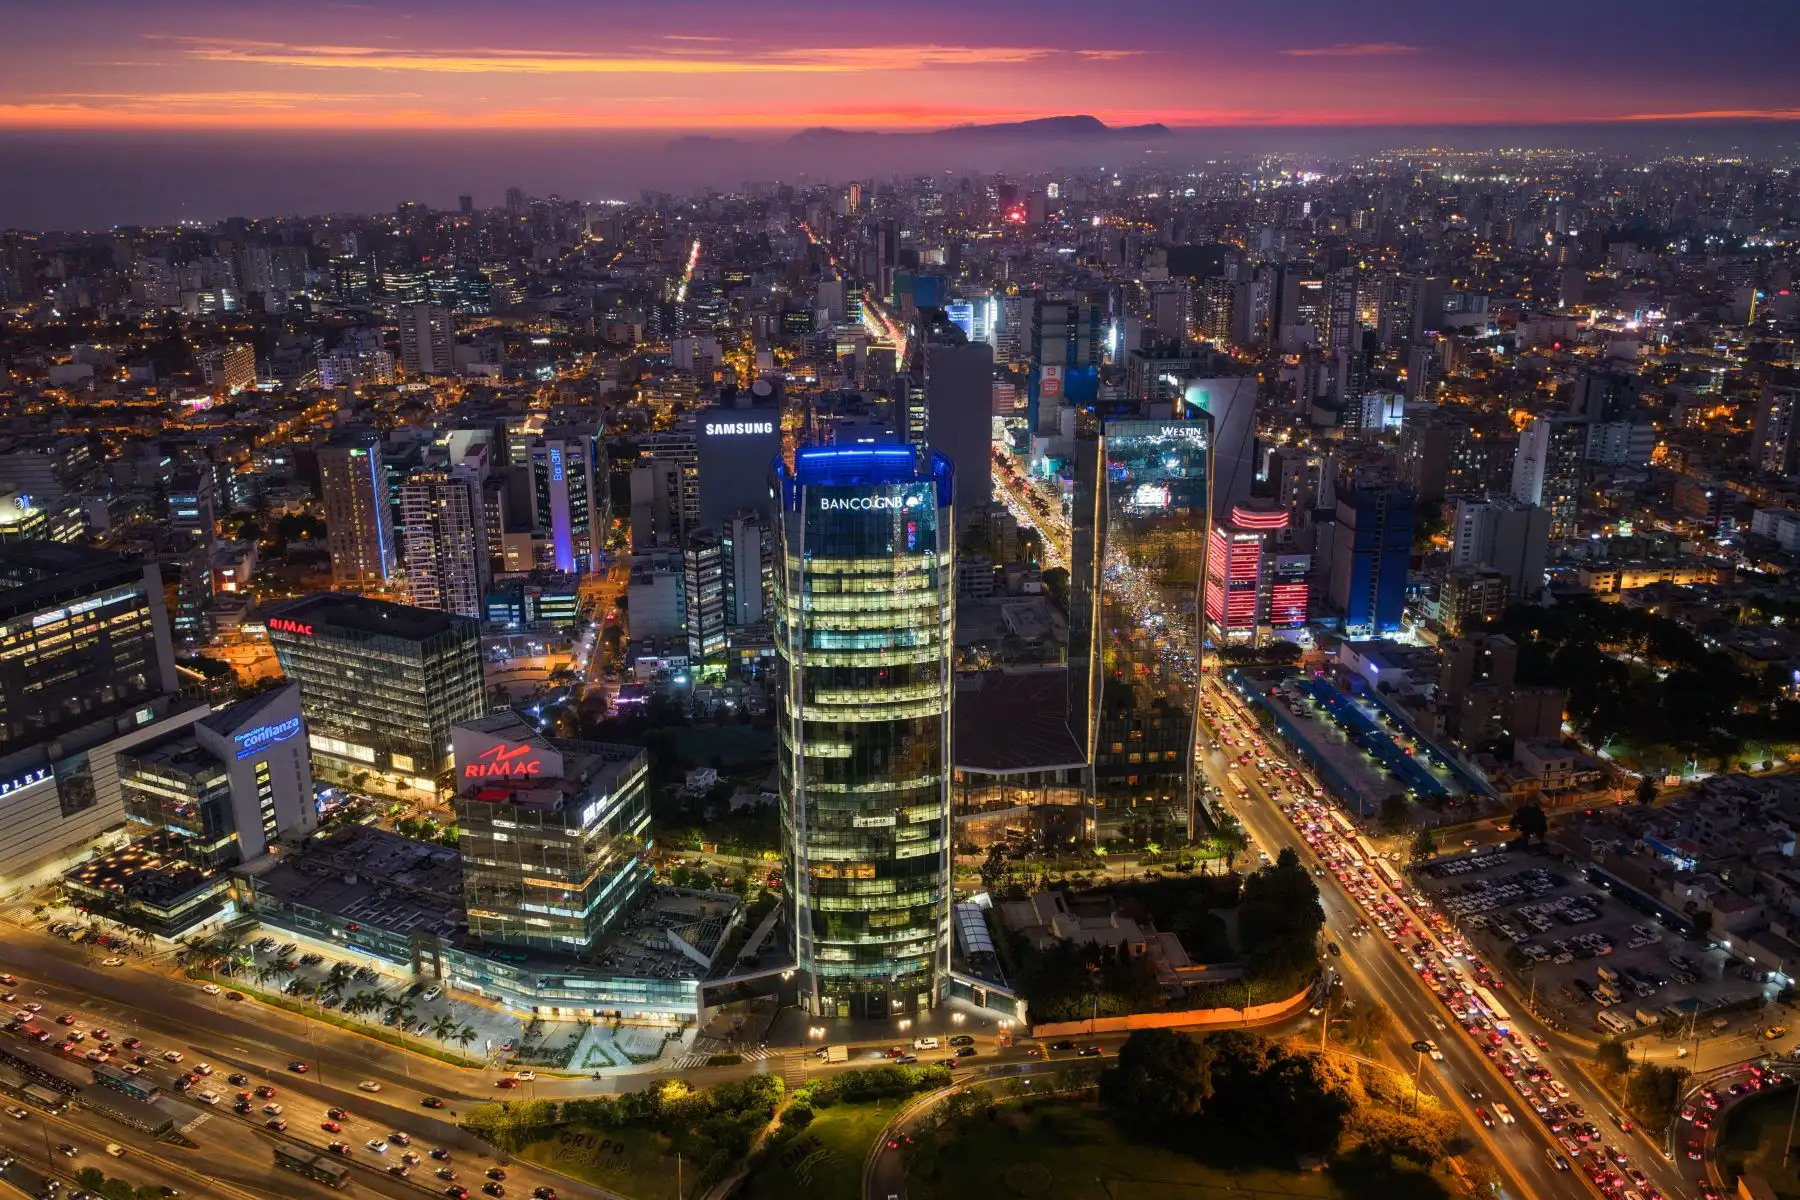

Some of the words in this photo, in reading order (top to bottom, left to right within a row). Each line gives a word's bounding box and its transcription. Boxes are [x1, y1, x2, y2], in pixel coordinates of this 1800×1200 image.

[705, 422, 773, 435] SAMSUNG
[821, 498, 872, 510] BANCO
[874, 497, 902, 509] GNB
[270, 618, 313, 635] RIMAC
[244, 717, 299, 747] confianza
[465, 760, 541, 777] RIMAC
[560, 1130, 625, 1155] GRUPO
